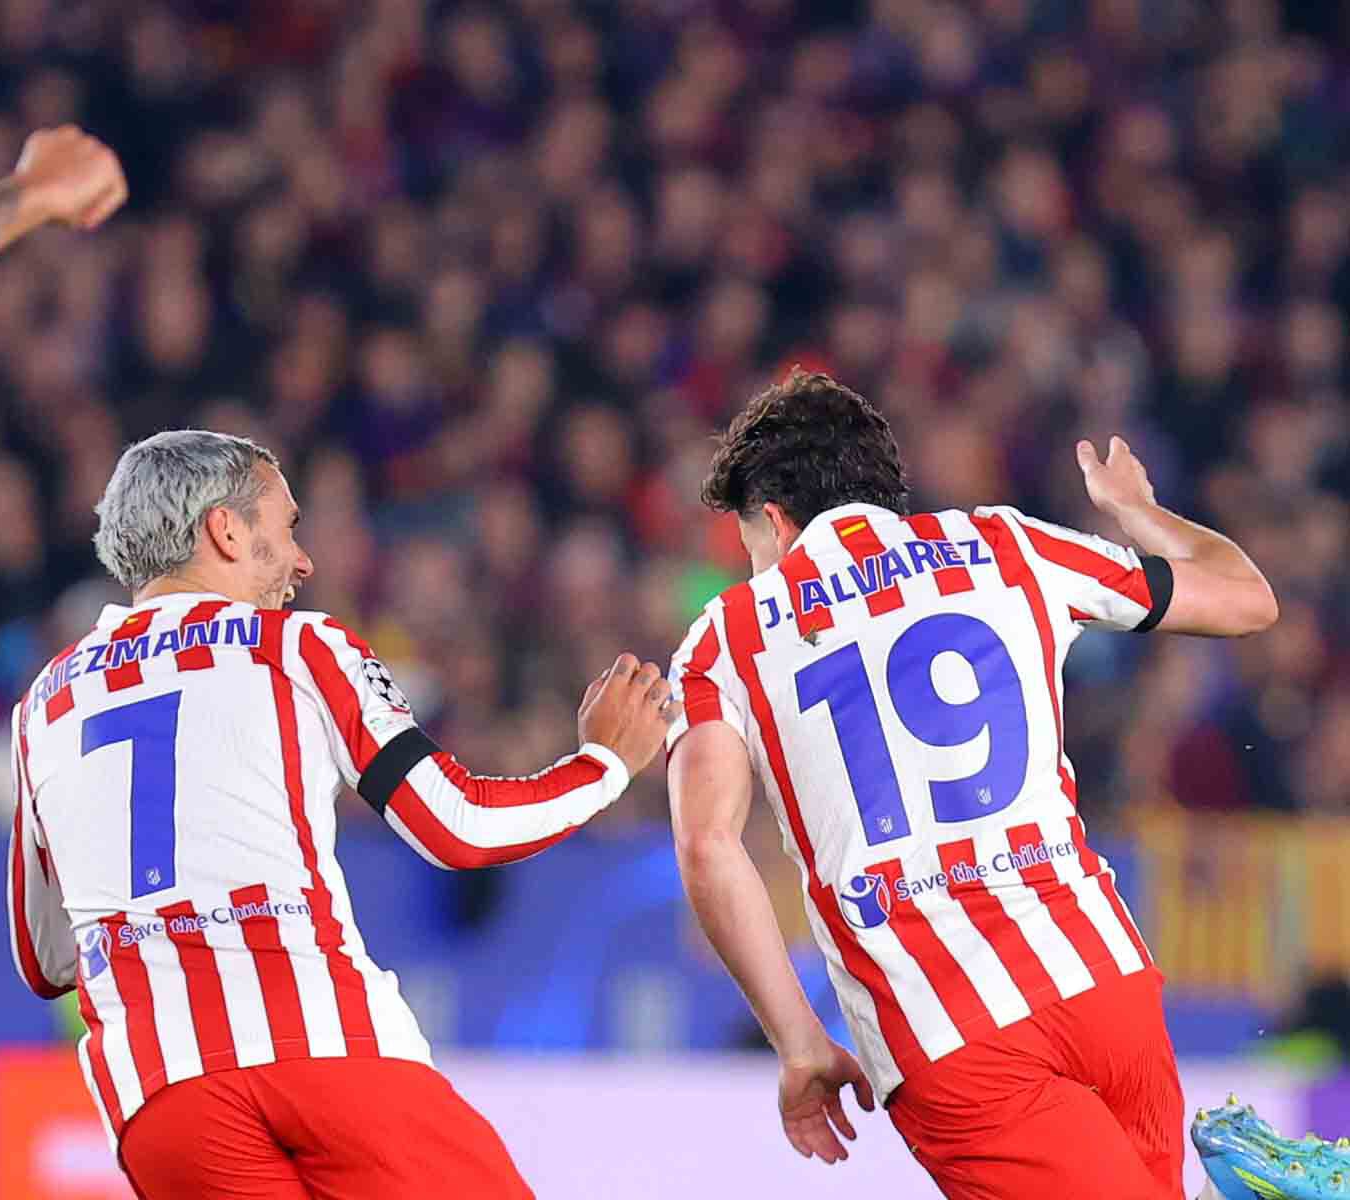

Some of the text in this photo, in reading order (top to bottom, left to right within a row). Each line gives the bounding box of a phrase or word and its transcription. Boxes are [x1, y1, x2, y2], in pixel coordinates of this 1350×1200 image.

[759, 539, 992, 628] J. ALVAREZ
[24, 616, 260, 722] RIEZMANN
[794, 613, 1029, 847] 19
[81, 690, 183, 900] 7
[895, 840, 1077, 899] Save the Children
[119, 902, 311, 946] Save the Children
